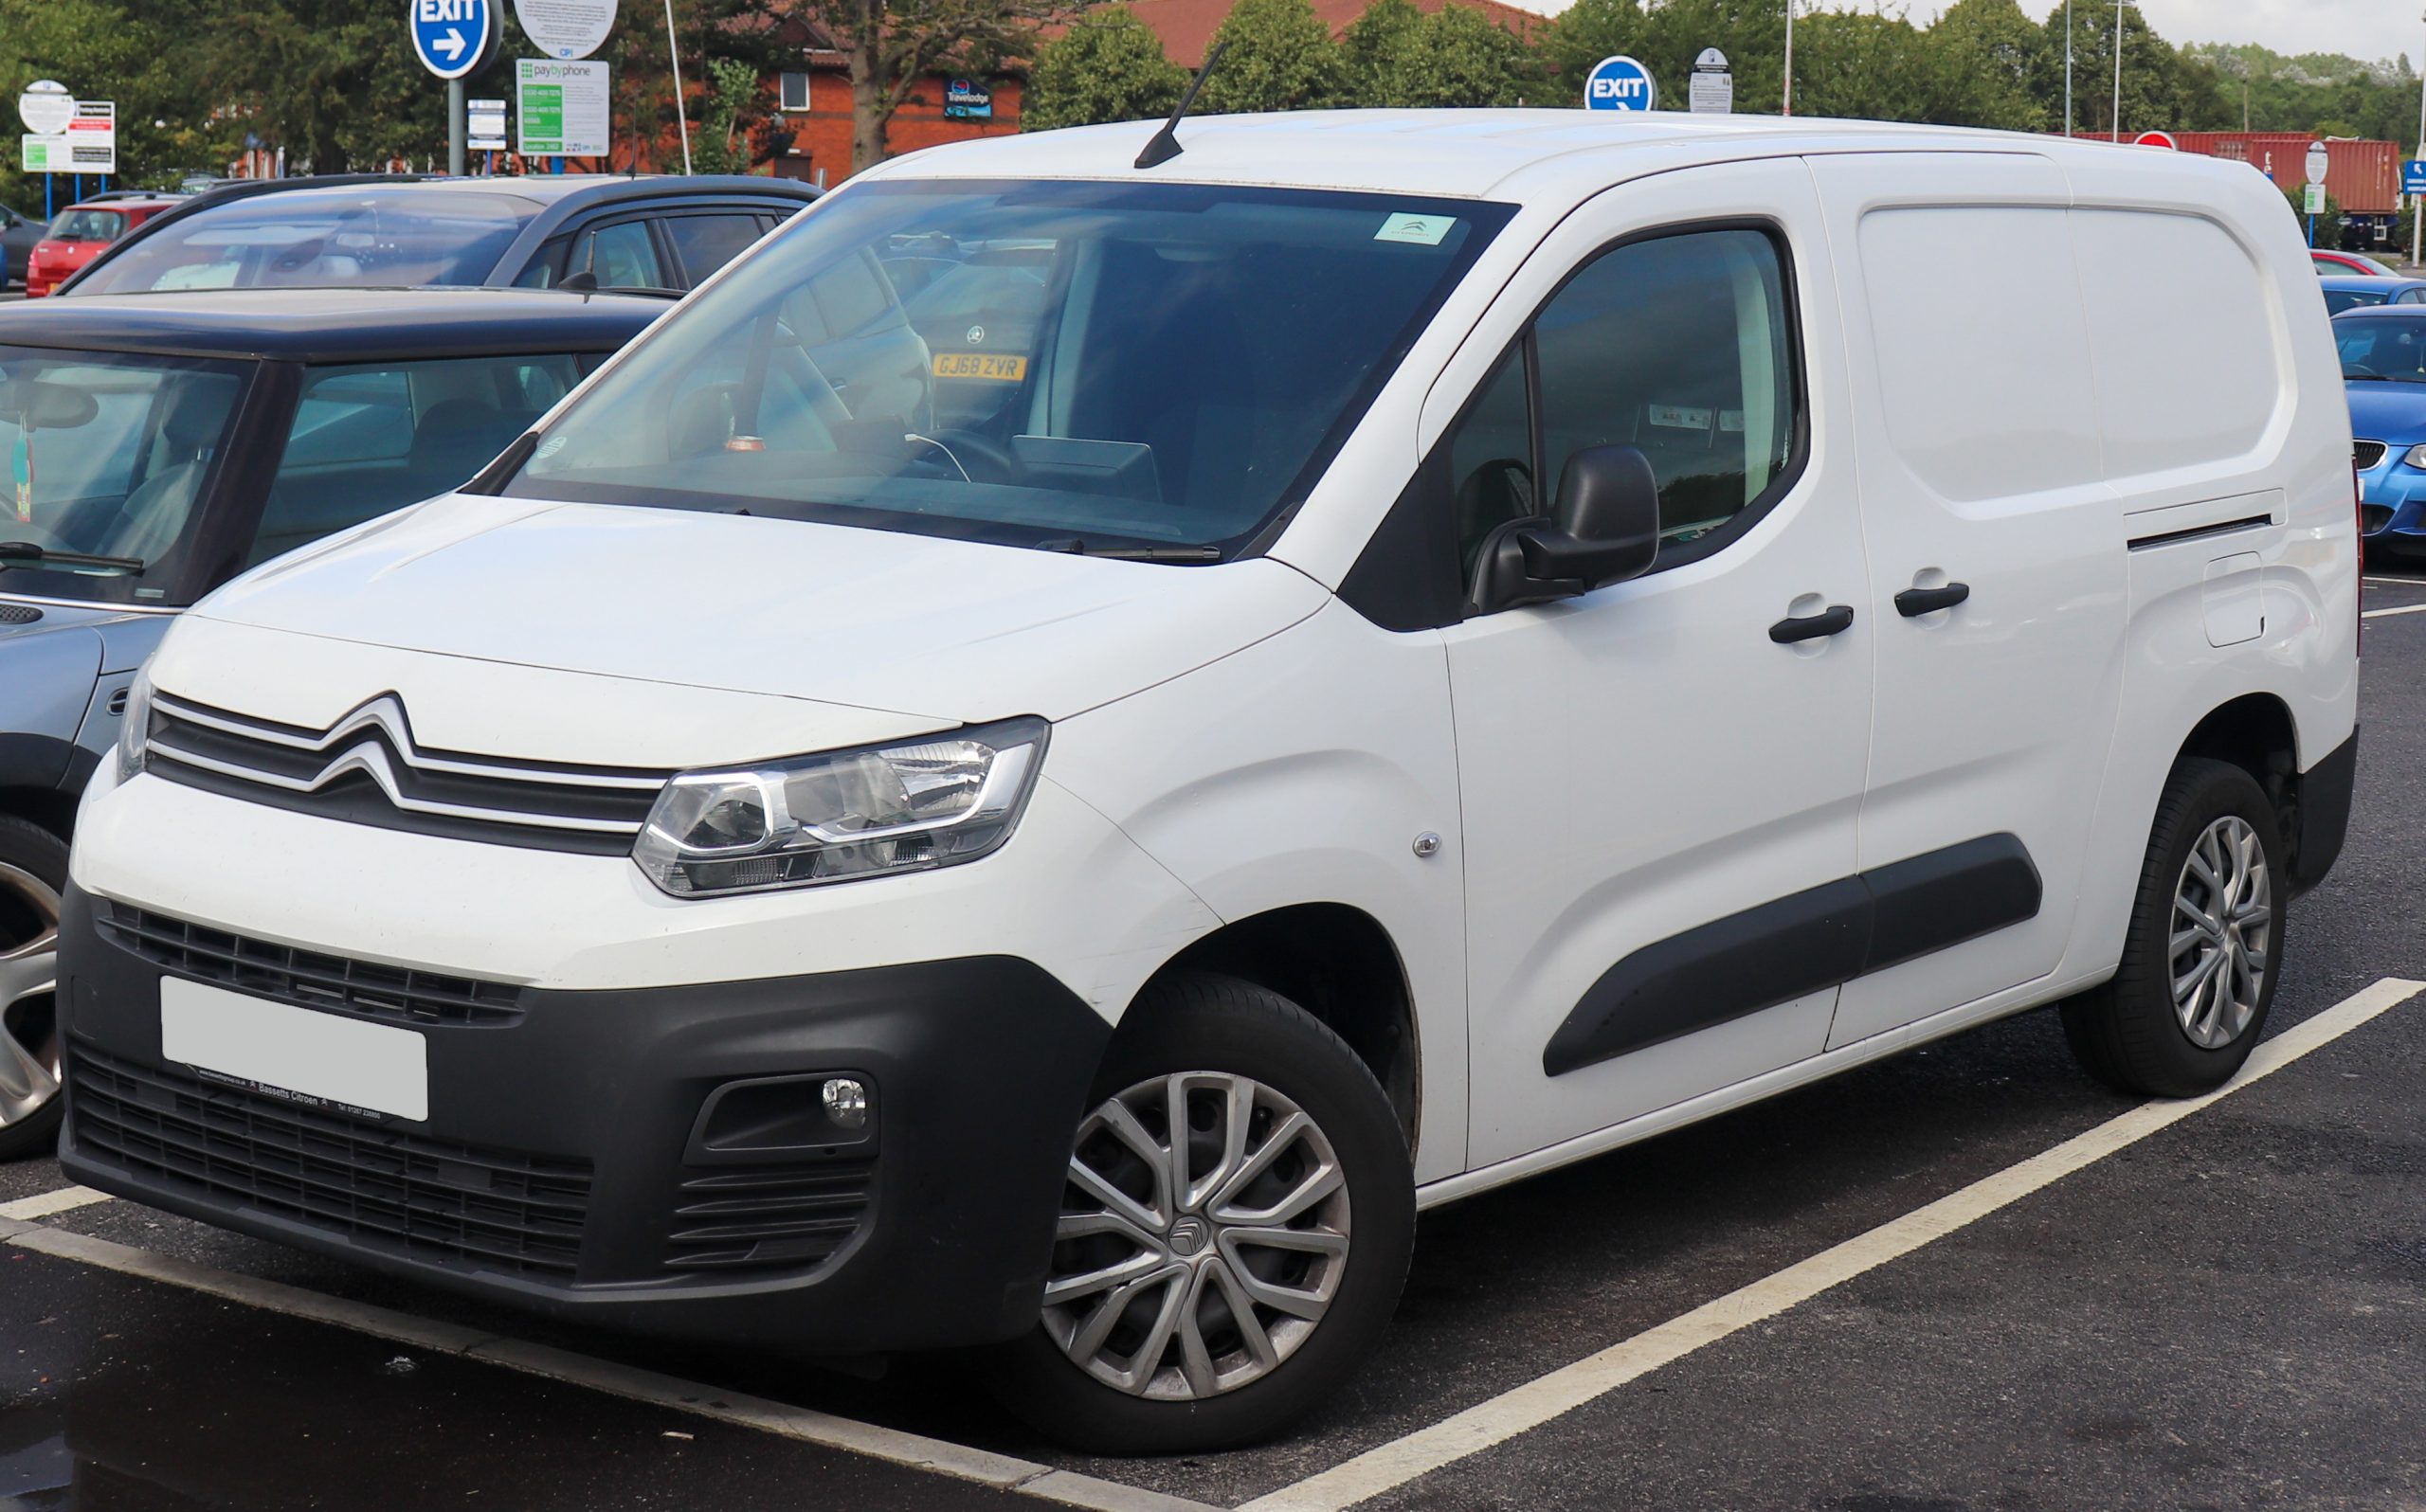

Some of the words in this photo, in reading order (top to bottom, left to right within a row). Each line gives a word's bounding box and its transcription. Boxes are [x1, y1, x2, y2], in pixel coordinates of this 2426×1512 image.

[420, 0, 477, 22] EXIT
[534, 63, 591, 78] paybyphone
[1593, 77, 1644, 99] EXIT
[939, 357, 980, 375] GJ68
[984, 358, 1018, 377] ZVR
[259, 1083, 289, 1099] Bassetts
[290, 1090, 318, 1106] Citroen
